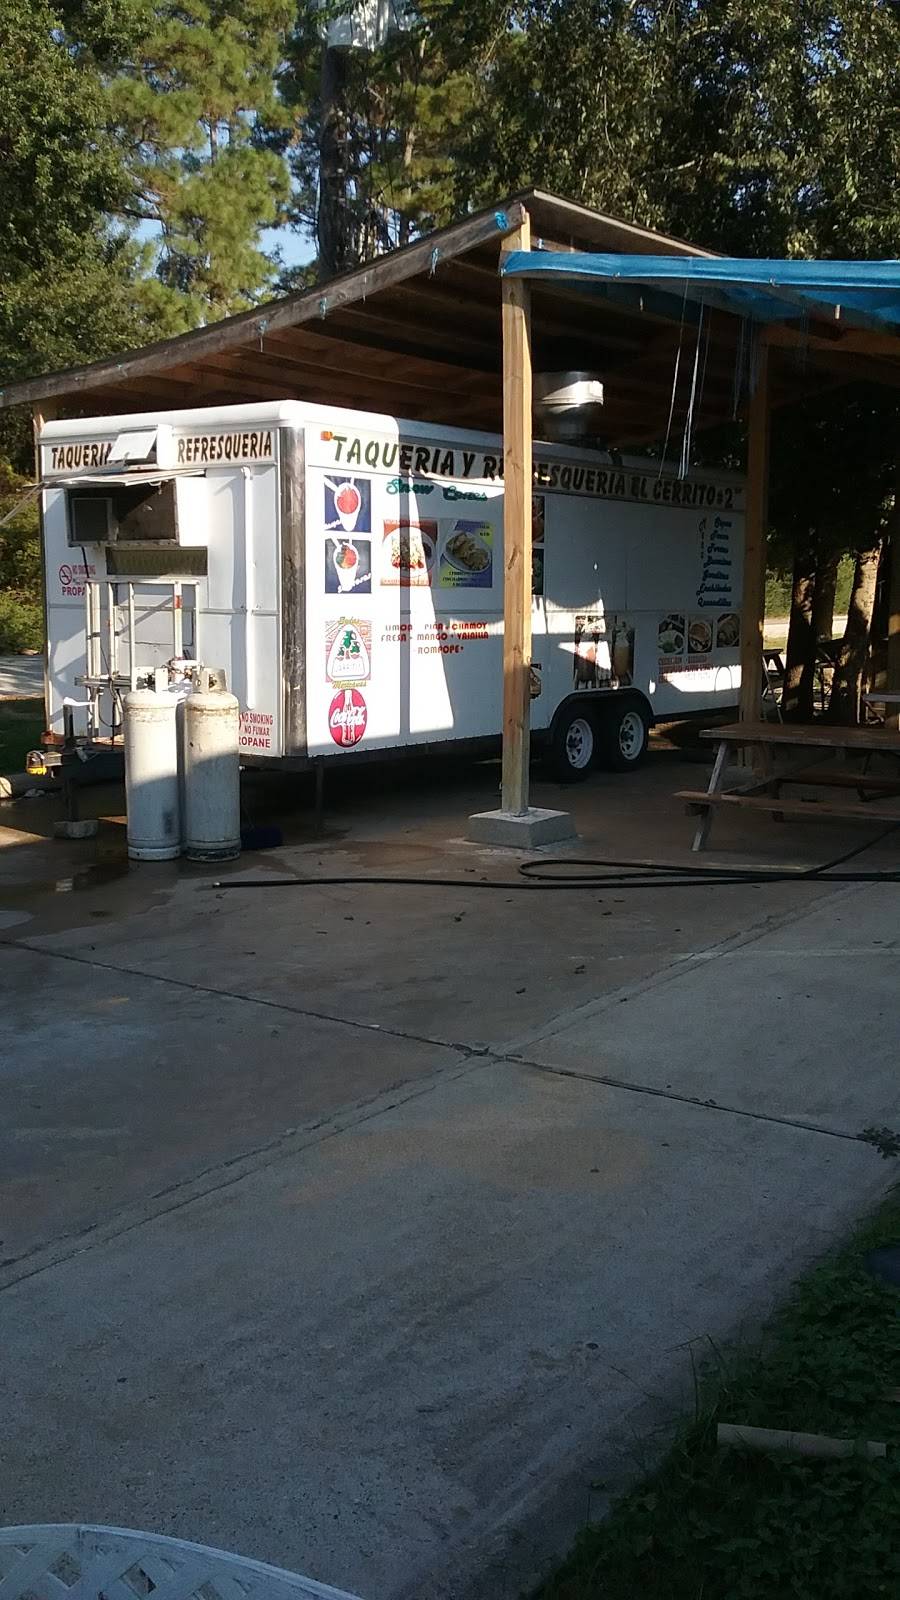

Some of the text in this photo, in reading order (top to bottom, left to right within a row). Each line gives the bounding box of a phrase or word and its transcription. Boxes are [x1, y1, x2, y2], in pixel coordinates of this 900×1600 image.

[177, 431, 272, 463] REFRESQUERIA
[333, 435, 454, 477] TAQUERIA
[462, 453, 476, 478] Y
[386, 478, 489, 501] Snow Cones
[385, 624, 413, 632] LIMON
[451, 622, 488, 631] CHAMOY
[381, 634, 407, 642] FRESA
[416, 632, 448, 641] MANGO
[418, 644, 460, 654] ROMPOPE
[240, 712, 274, 725] NO SMOKING
[244, 725, 270, 736] NO FUMAR
